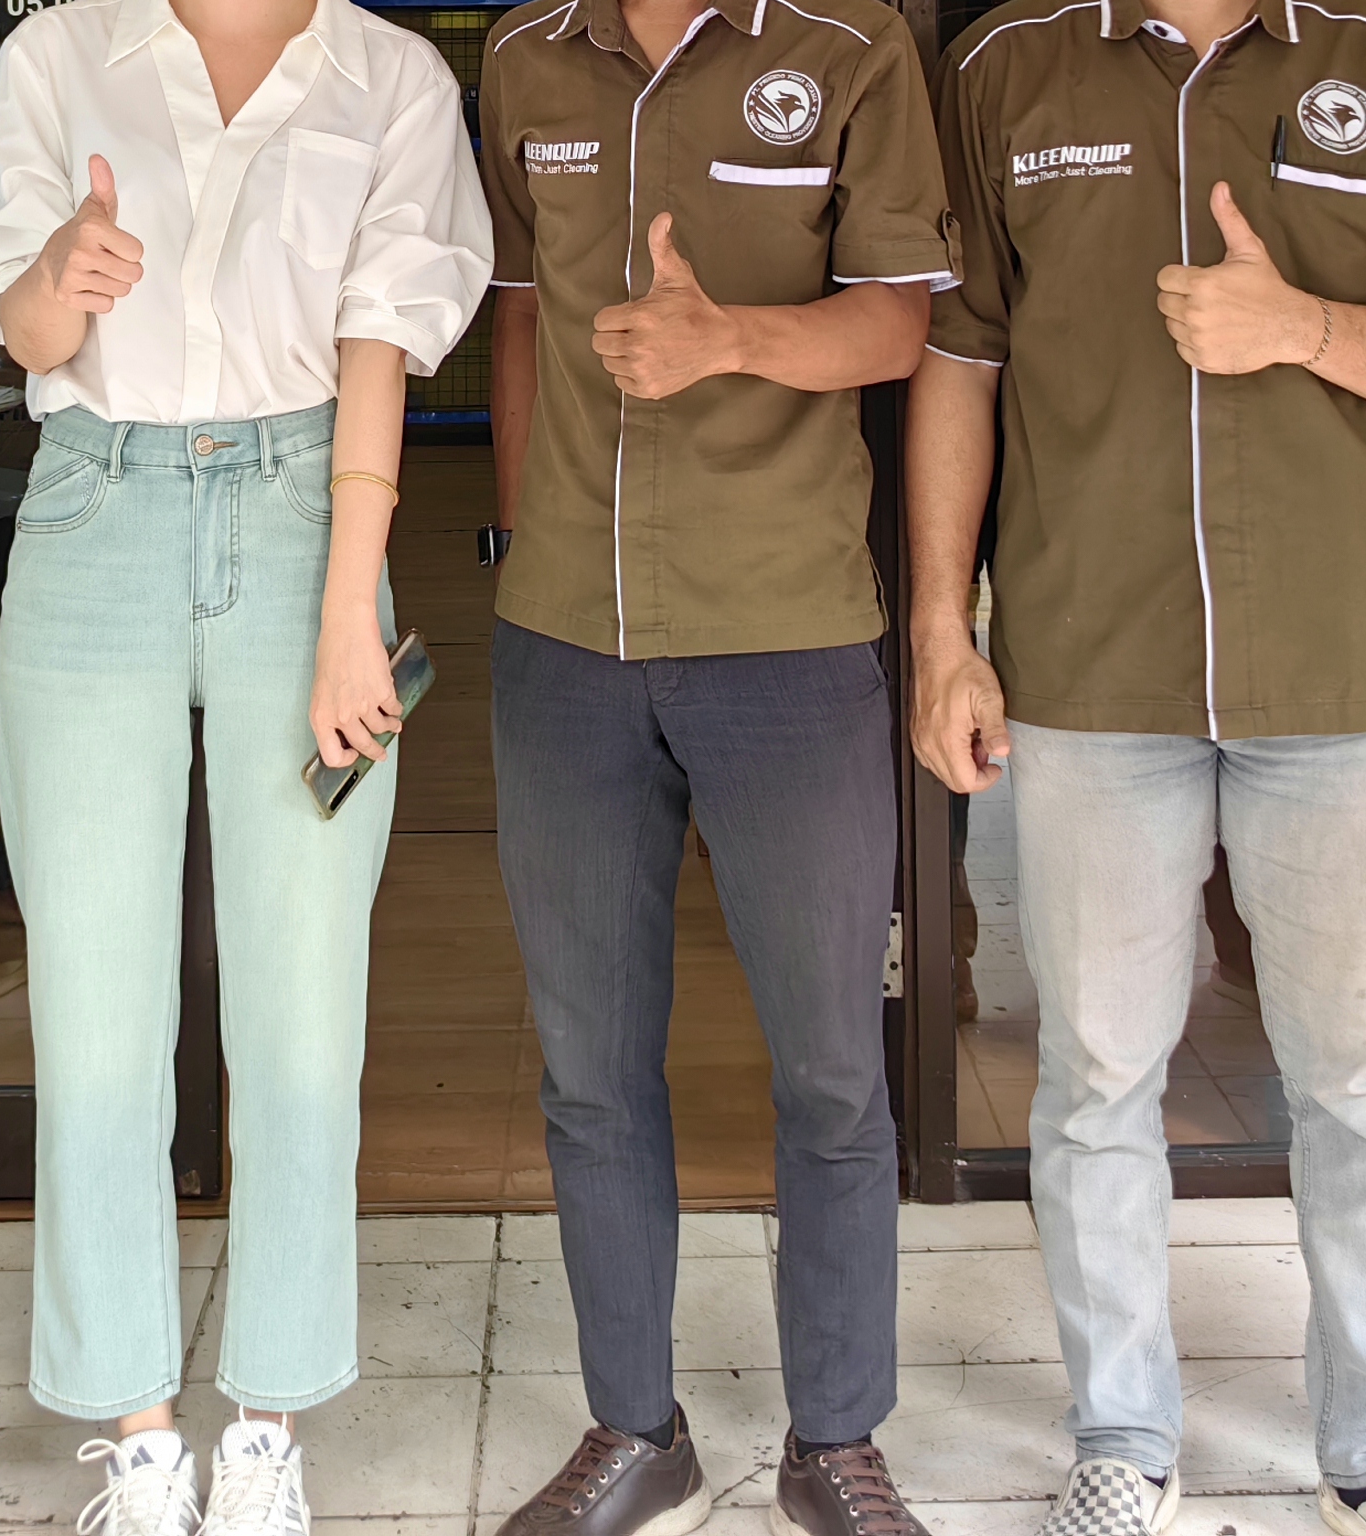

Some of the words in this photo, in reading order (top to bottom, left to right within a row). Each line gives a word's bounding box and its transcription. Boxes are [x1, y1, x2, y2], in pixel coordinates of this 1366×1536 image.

[524, 141, 600, 163] LEENQUIP
[1013, 144, 1132, 174] KLEENQUIP
[1088, 164, 1133, 176] Cleaning
